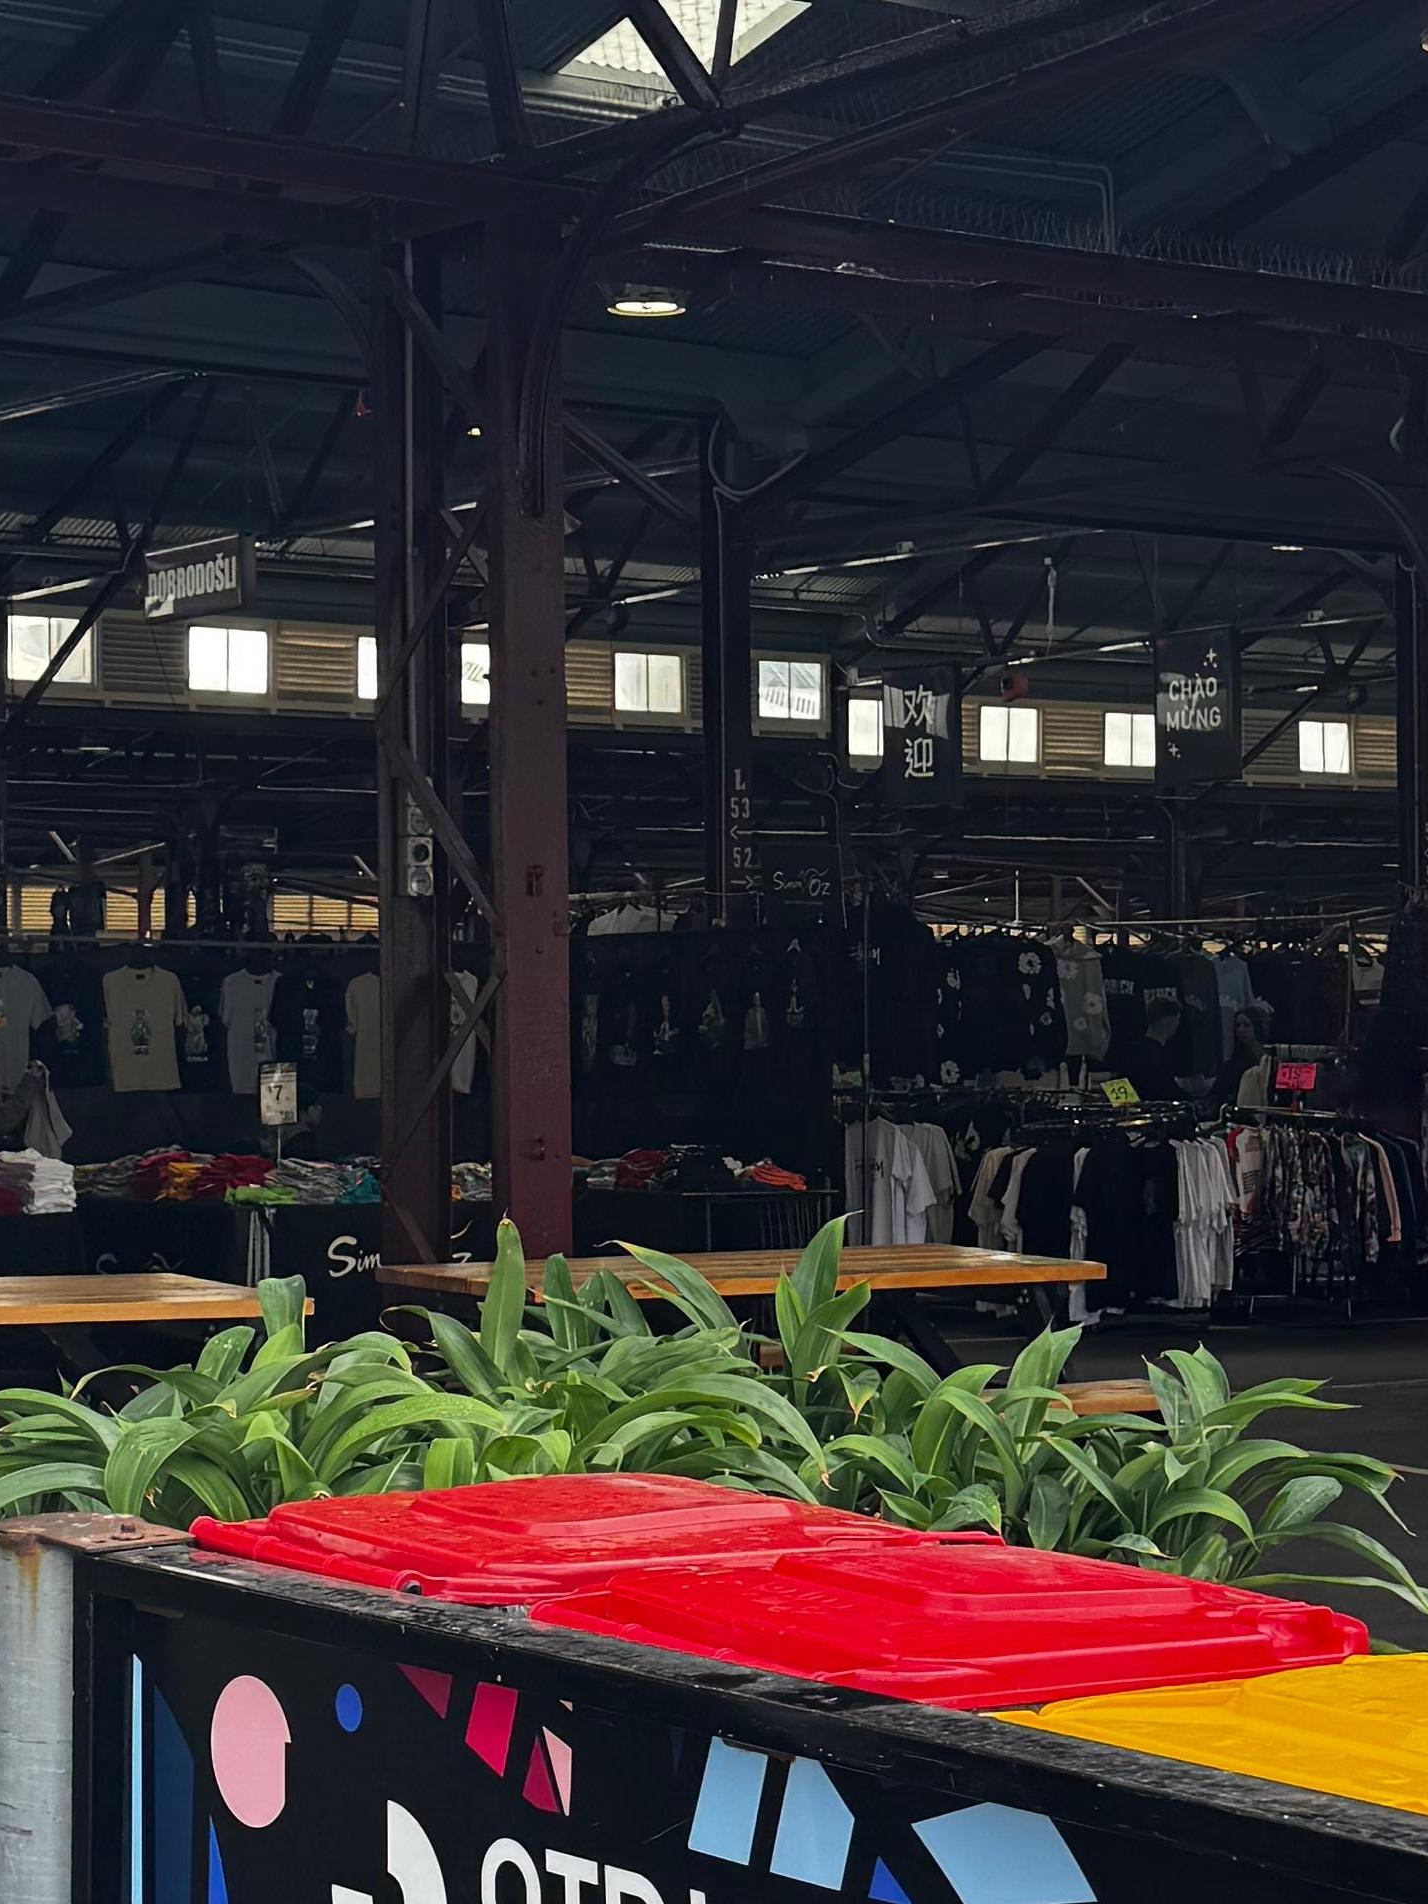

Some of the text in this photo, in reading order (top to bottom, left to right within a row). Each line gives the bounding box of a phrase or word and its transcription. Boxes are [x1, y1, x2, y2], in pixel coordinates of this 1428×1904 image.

[148, 553, 236, 602] DOBRODOŠLI
[904, 684, 935, 778] 欢迎
[733, 769, 746, 791] L
[730, 797, 751, 818] 53
[733, 848, 752, 867] 52
[327, 1235, 383, 1279] Sim
